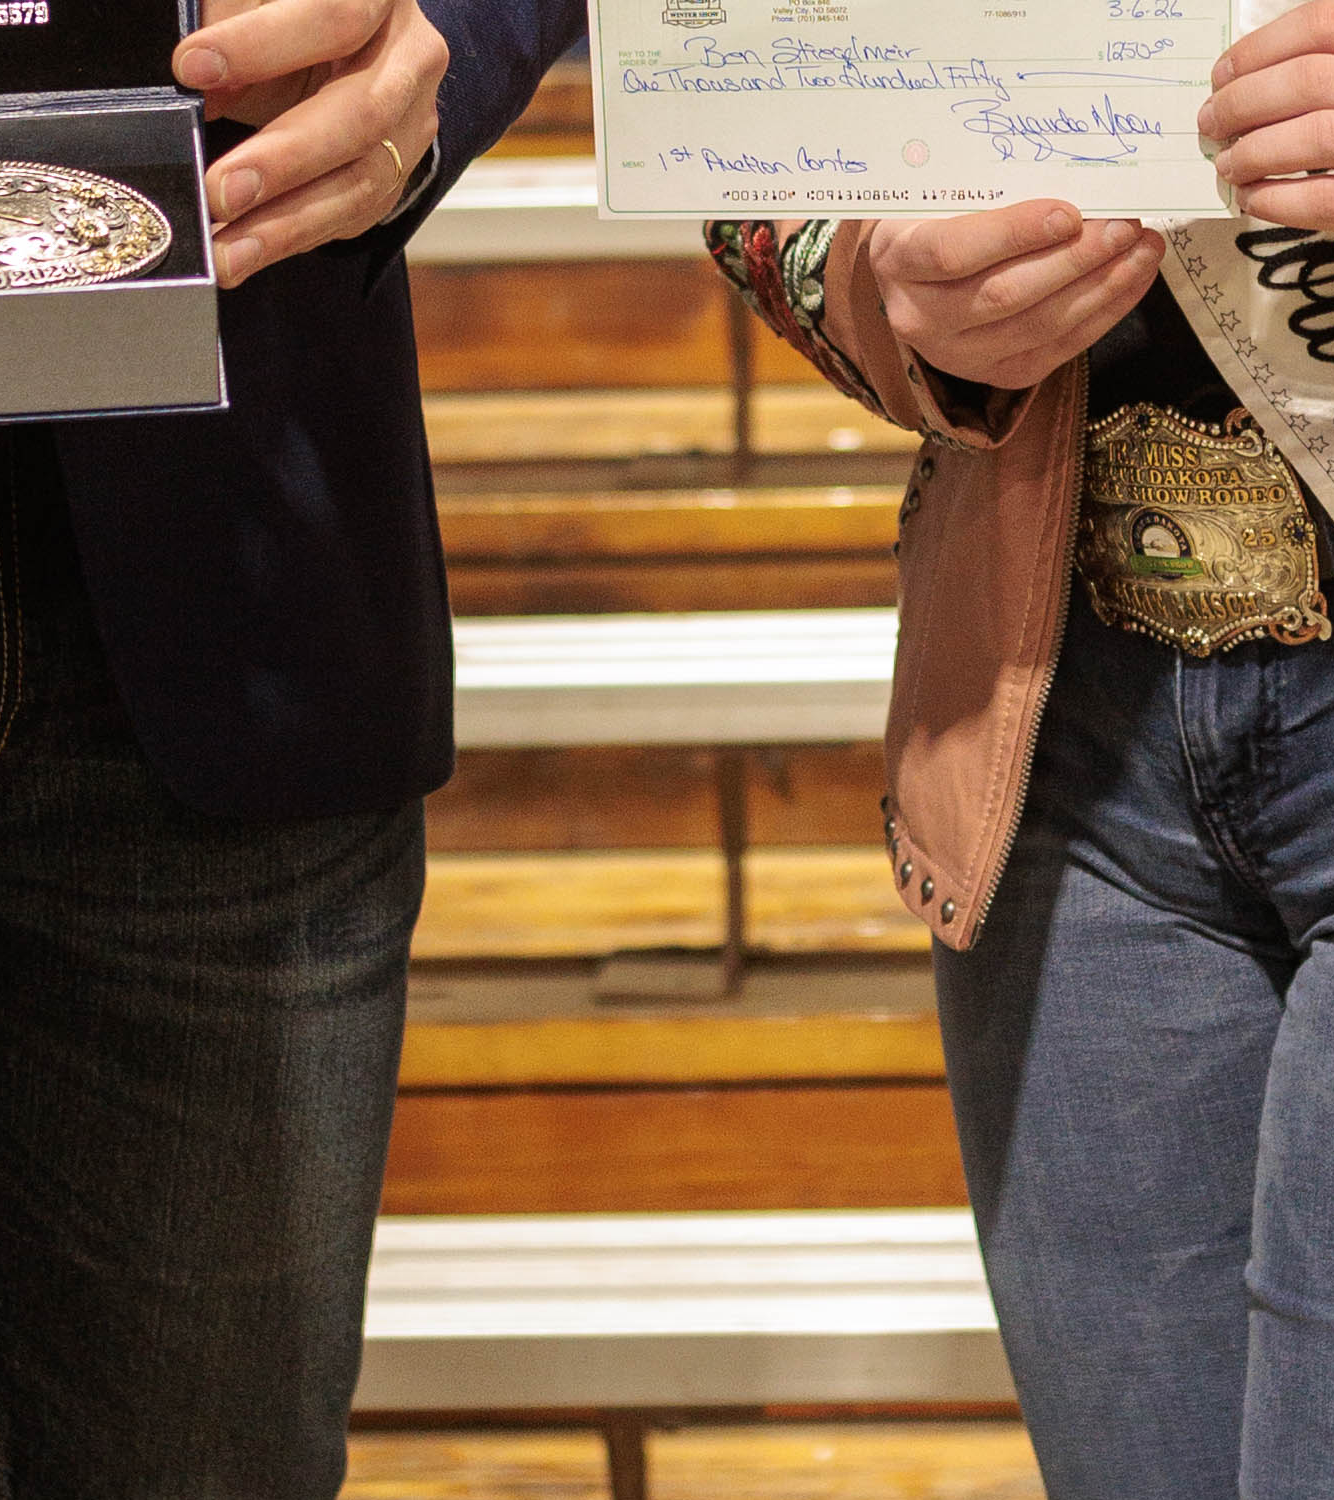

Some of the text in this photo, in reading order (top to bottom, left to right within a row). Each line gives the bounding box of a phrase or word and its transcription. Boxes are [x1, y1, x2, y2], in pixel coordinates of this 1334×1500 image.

[773, 7, 792, 15] Valley
[826, 6, 848, 14] 58072
[798, 15, 815, 24] (701)
[623, 68, 659, 93] One
[653, 64, 787, 93] Thousand
[783, 65, 836, 88] Two
[622, 160, 645, 168] MEMO
[659, 145, 694, 171] 1st
[1143, 443, 1198, 469] MISS
[1149, 467, 1244, 487] DAKOTA
[1198, 484, 1286, 505] RODEO
[1242, 527, 1276, 548] 25
